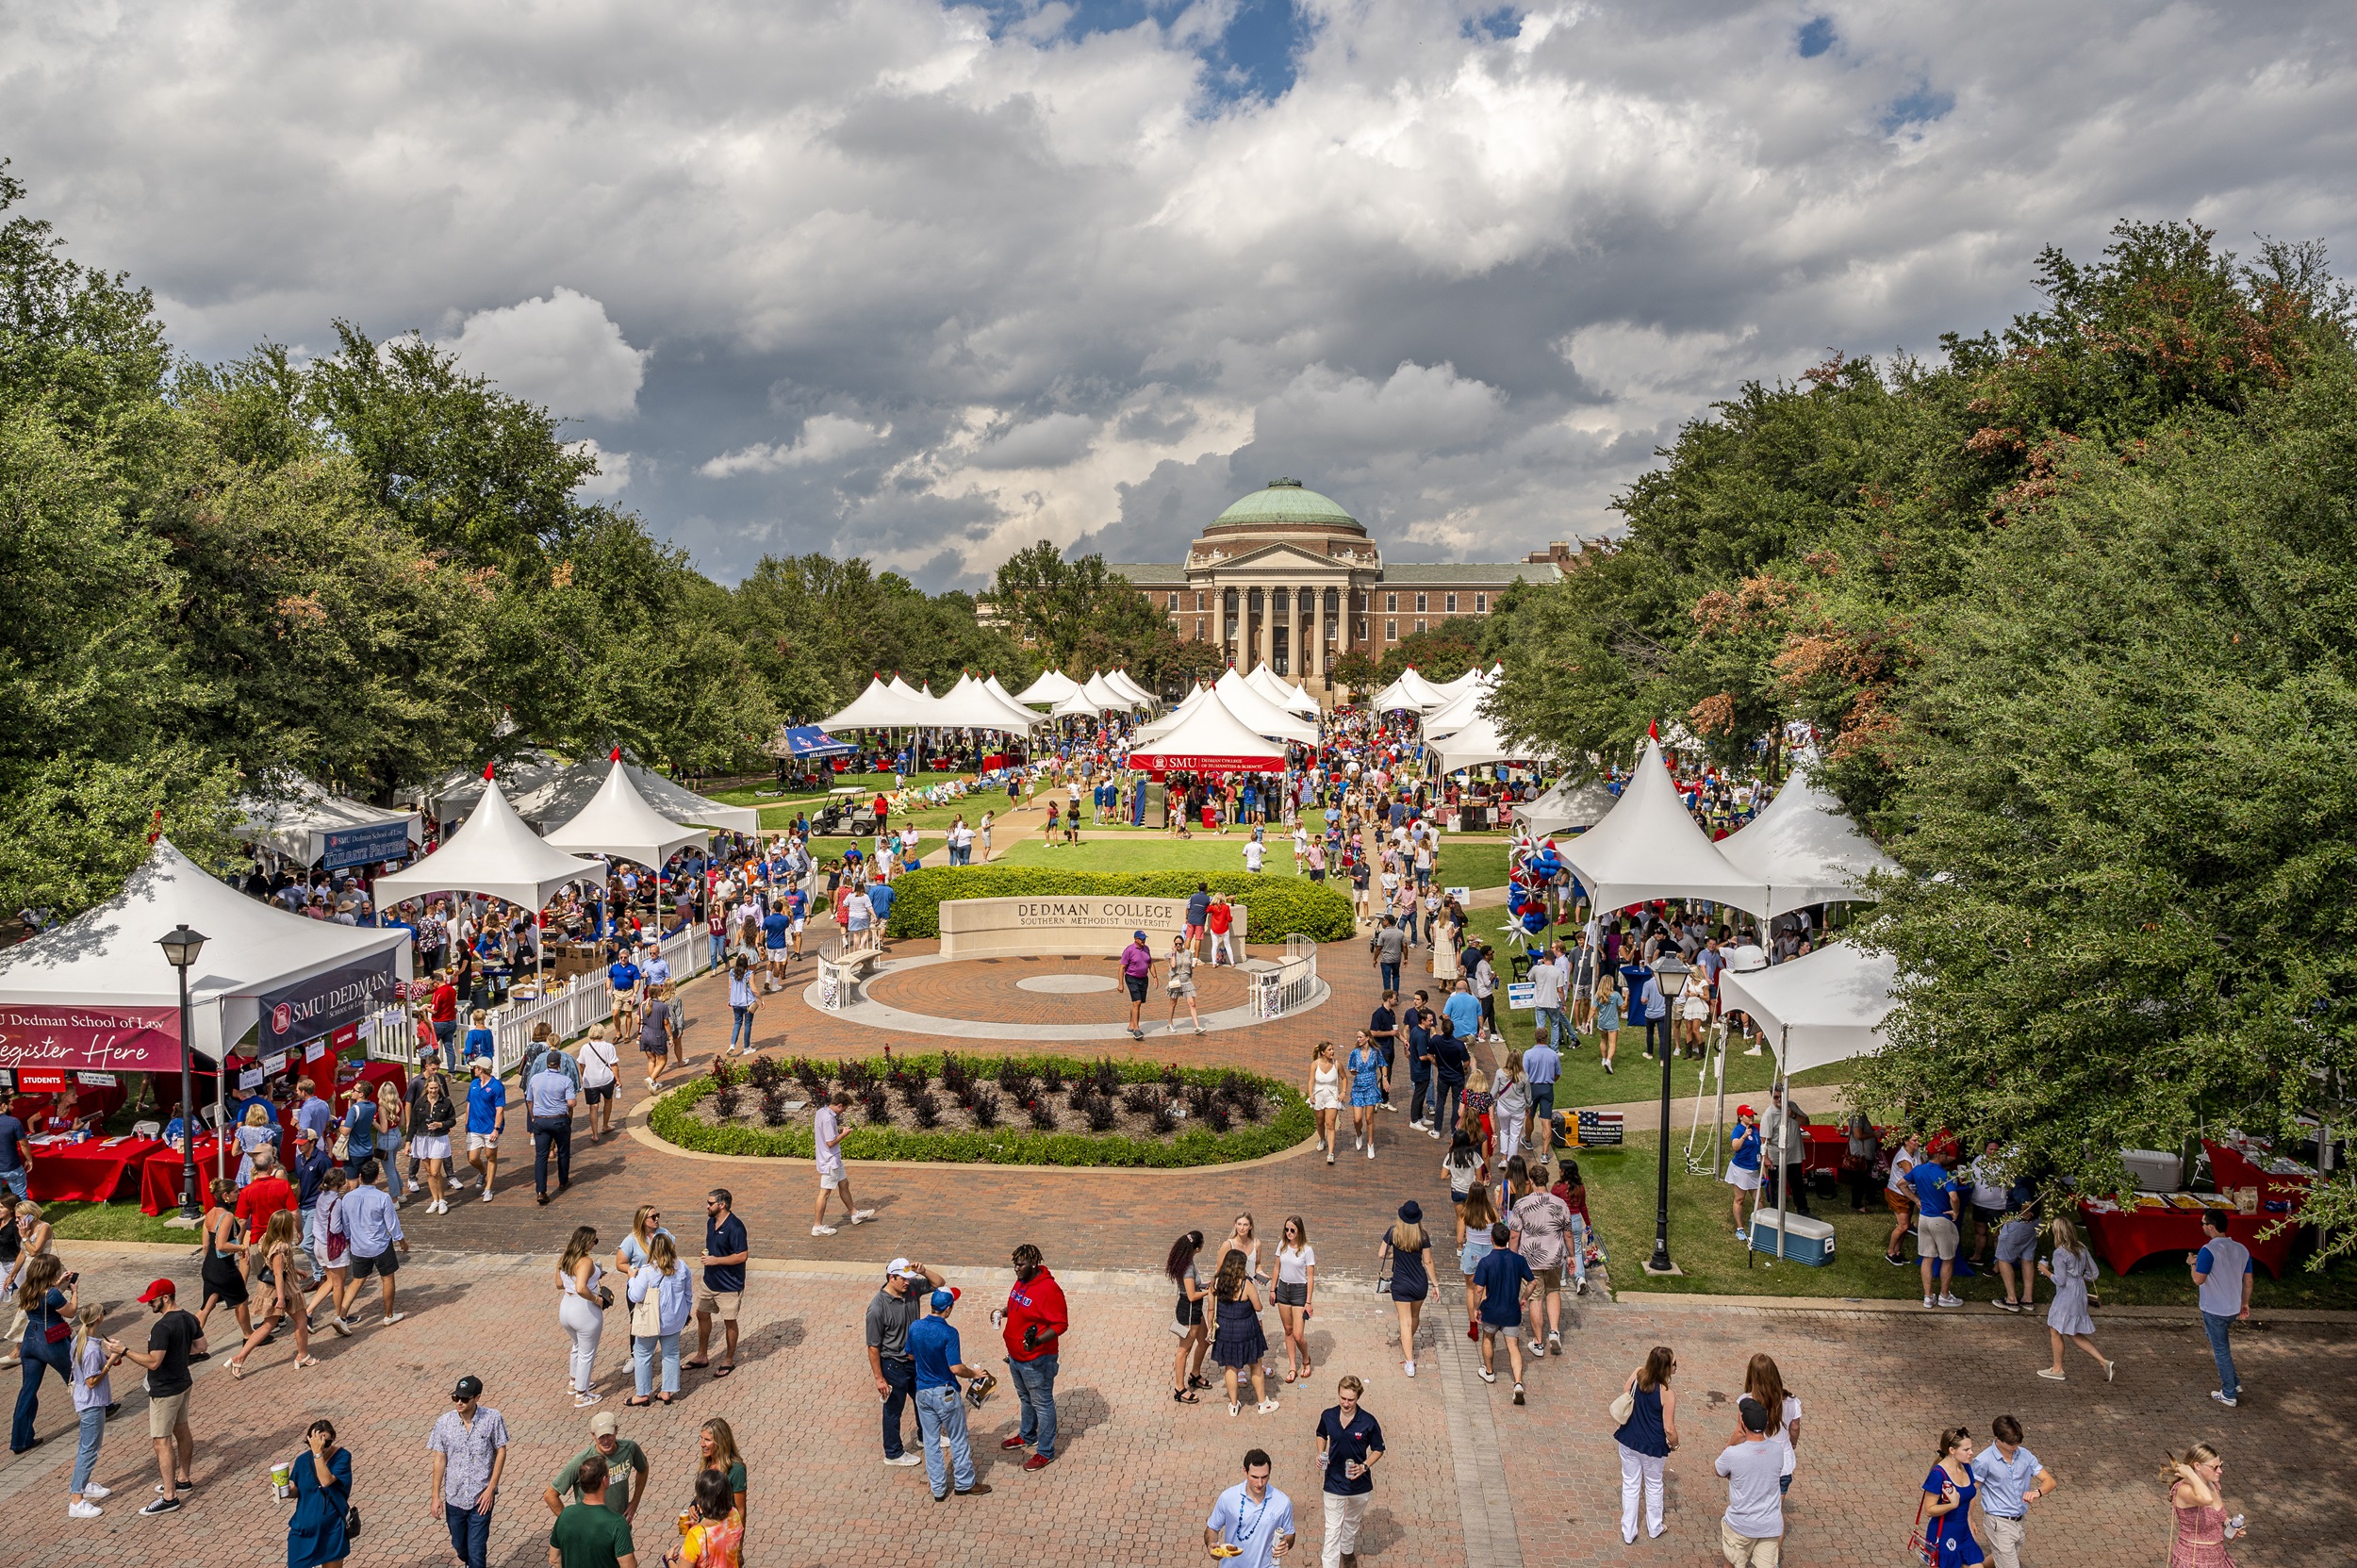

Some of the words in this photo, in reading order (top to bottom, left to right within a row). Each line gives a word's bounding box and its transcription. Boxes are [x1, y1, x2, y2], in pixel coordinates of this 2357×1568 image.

[1169, 758, 1197, 767] SMU
[352, 834, 371, 842] Dedman
[1018, 903, 1089, 916] DEDMAN
[1103, 904, 1172, 918] COLLEGE
[710, 918, 724, 930] TX
[1071, 917, 1120, 925] METHODIST
[1124, 917, 1170, 927] UNIVERSITY
[292, 995, 325, 1023] SMU
[330, 971, 387, 1009] DEDMAN
[329, 1006, 348, 1018] SCHOOL
[11, 1014, 67, 1027] Dedman
[71, 1015, 115, 1028] School
[120, 1017, 135, 1028] of
[137, 1017, 165, 1030] Law
[337, 1032, 353, 1044] ALUMNI
[82, 1034, 149, 1070] Here
[1010, 1289, 1032, 1306] SMU
[609, 1459, 630, 1477] BULLS
